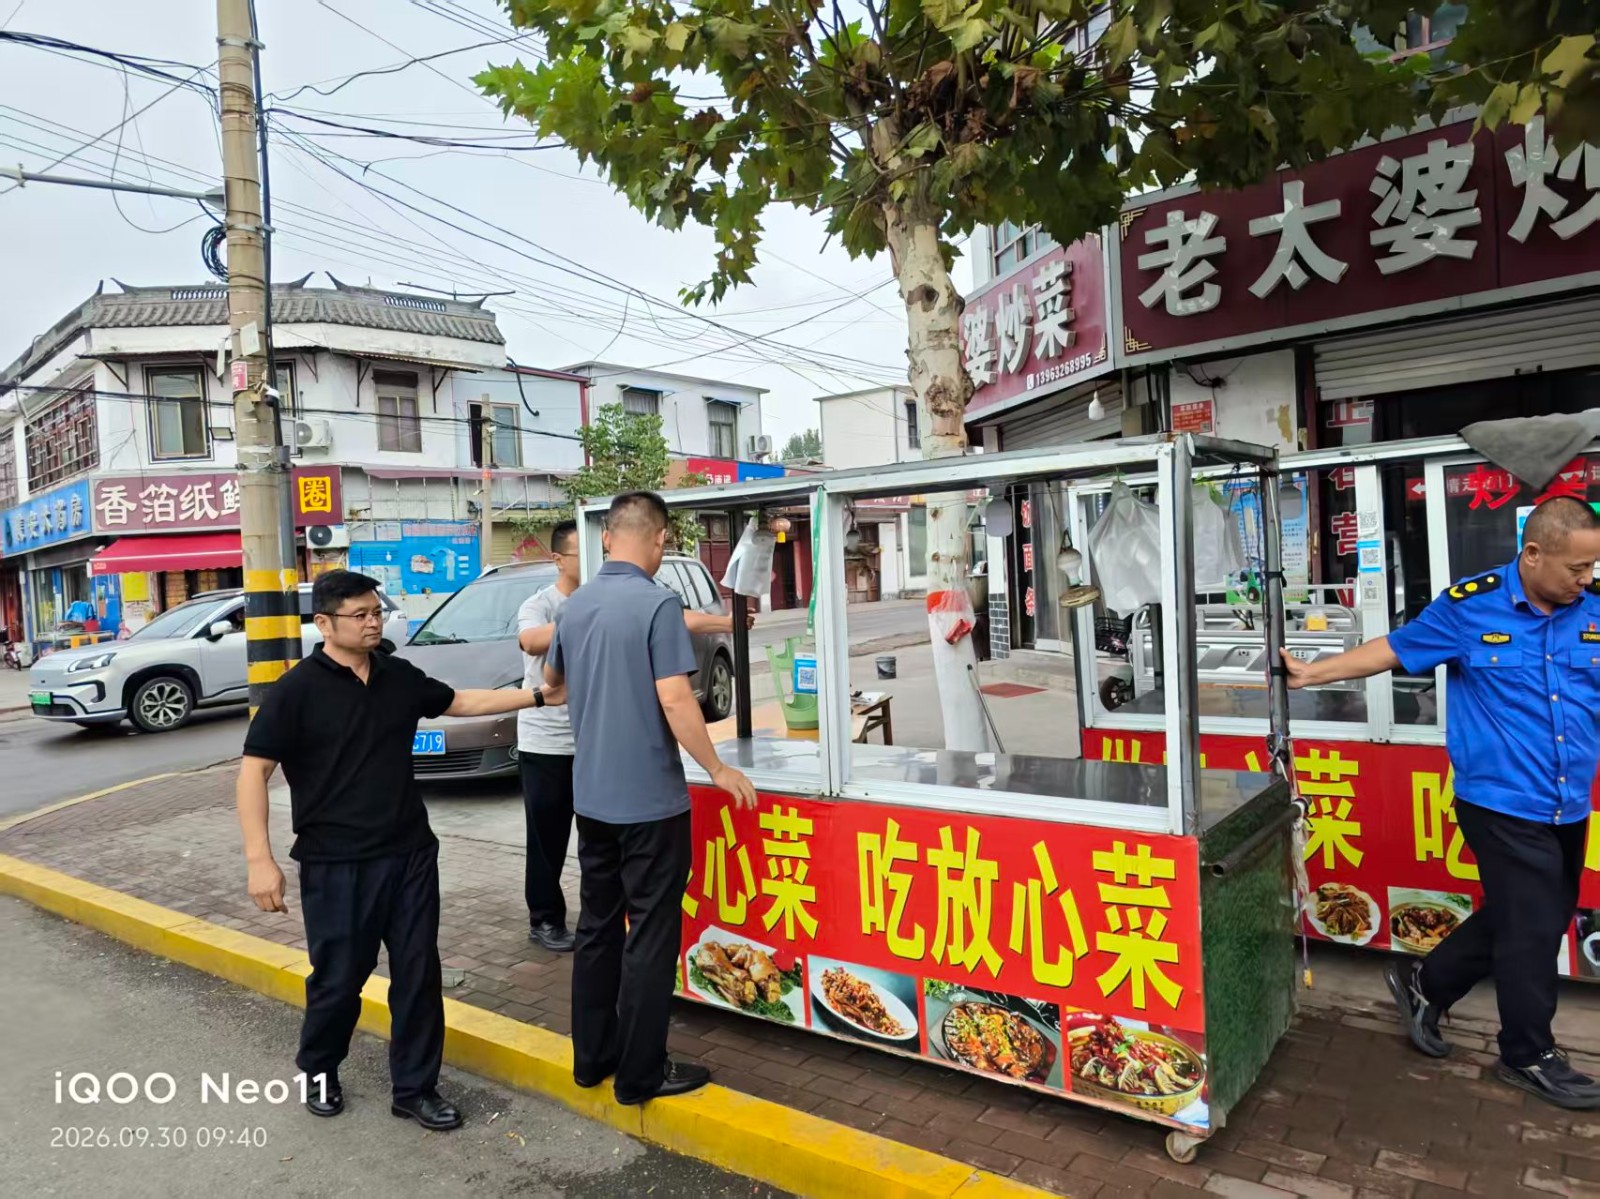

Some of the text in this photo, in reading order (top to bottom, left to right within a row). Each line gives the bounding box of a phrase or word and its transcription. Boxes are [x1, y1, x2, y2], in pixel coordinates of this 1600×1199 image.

[1035, 352, 1092, 386] 13963268995
[298, 476, 332, 514] 圈
[682, 803, 1184, 1011] 心菜 吃放心菜
